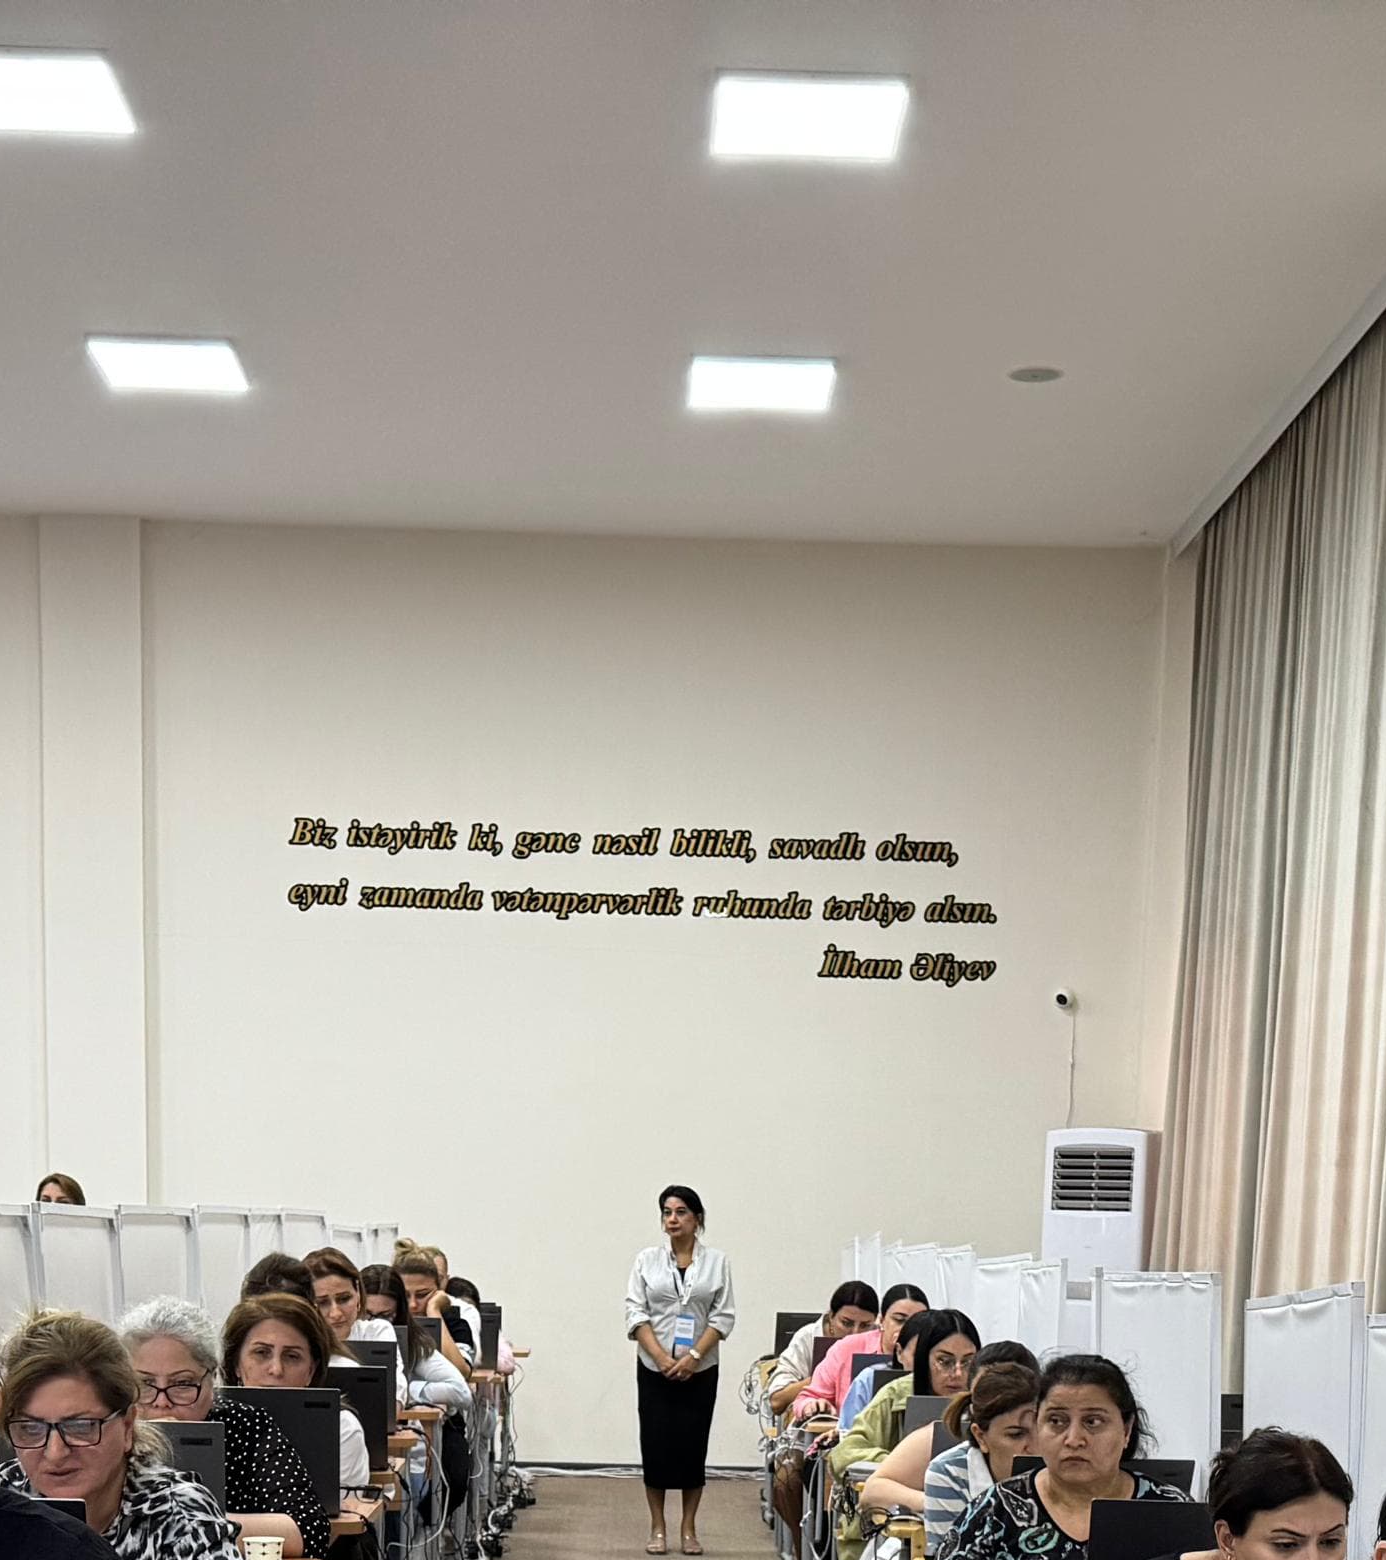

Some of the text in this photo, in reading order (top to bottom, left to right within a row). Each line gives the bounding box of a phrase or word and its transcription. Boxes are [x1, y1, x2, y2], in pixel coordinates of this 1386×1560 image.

[289, 817, 960, 868] Biz istəyirik ki, gənc nəsil bilikli, savadlı olsun,
[287, 877, 998, 929] eyni zamanda vətənpərvərlik ruhunda tərbiyə alsın.
[816, 943, 997, 988] İlham Əliyev
